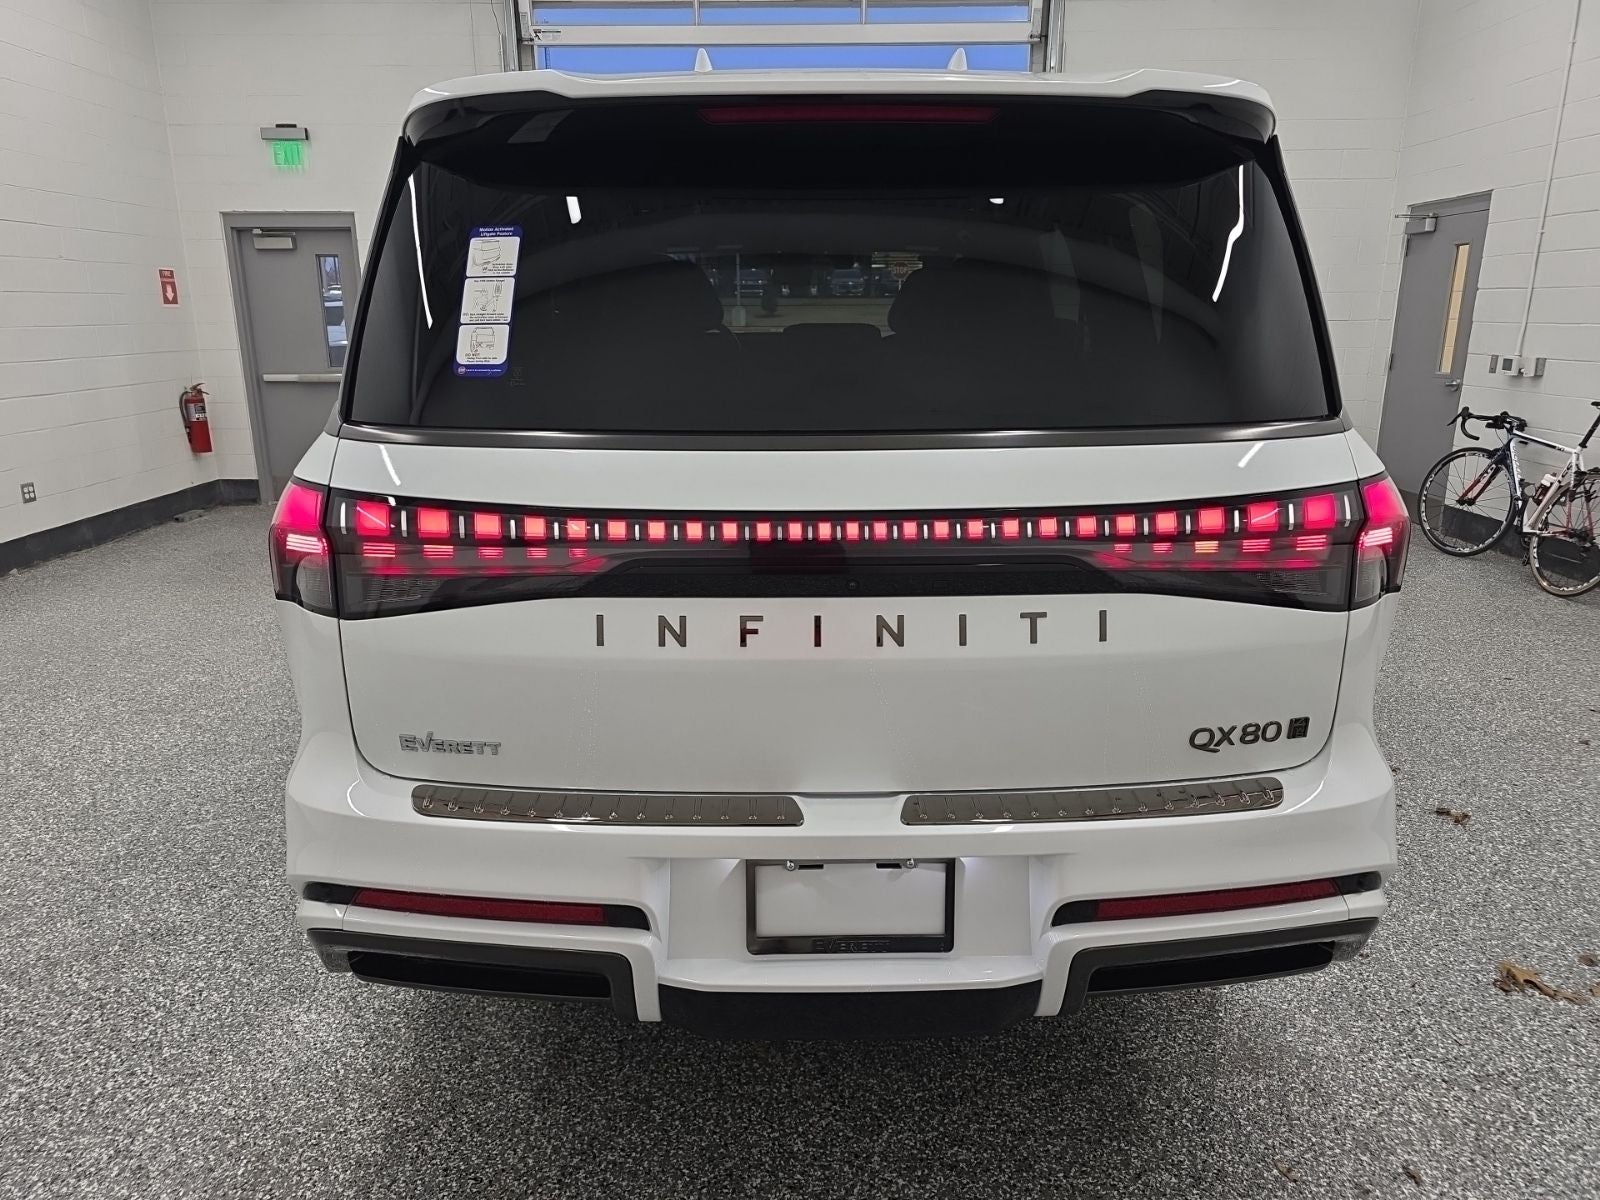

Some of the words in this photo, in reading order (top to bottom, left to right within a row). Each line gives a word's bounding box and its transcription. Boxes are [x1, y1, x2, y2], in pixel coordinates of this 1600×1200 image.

[273, 142, 302, 166] EXIT
[596, 609, 1108, 647] INFINITI
[399, 731, 501, 756] EVERETT
[1188, 720, 1283, 754] QX80
